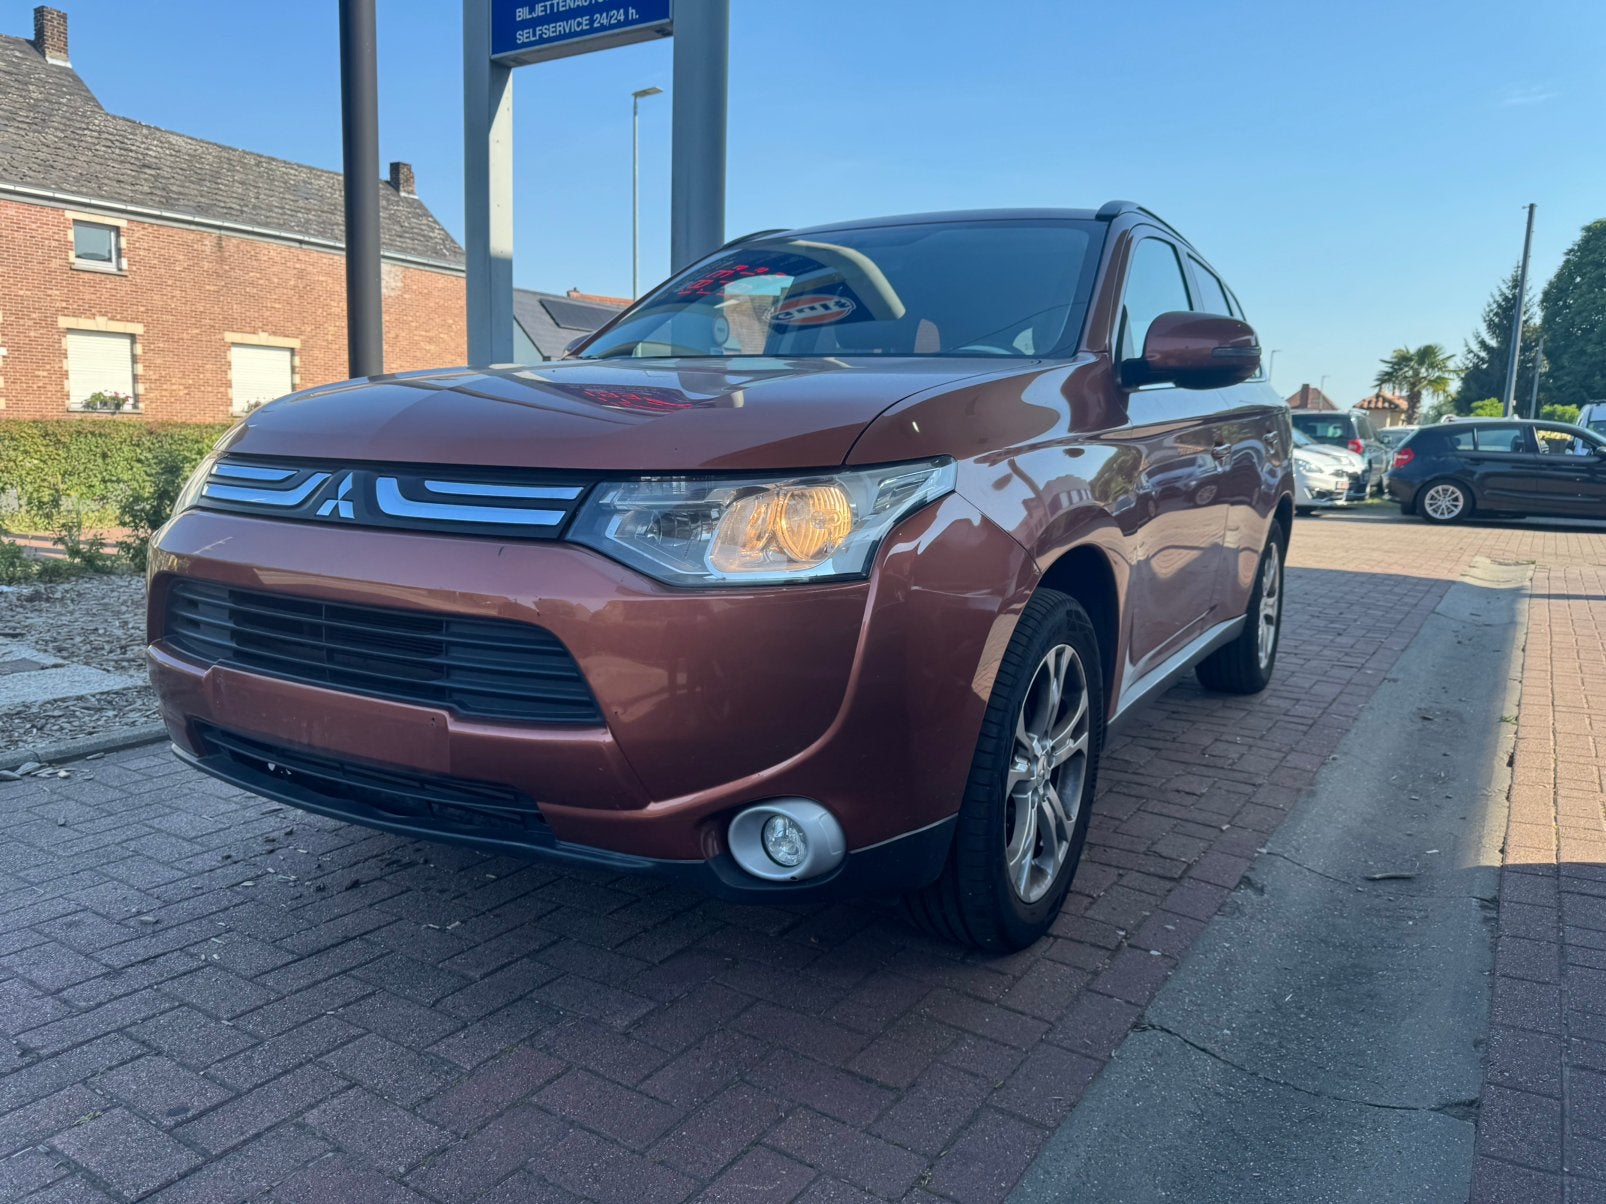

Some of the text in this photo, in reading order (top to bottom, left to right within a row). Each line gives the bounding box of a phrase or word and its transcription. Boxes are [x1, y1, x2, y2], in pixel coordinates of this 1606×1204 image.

[515, 0, 604, 21] BILJETTENAU
[516, 6, 640, 44] SELFSERVICE 24/24 h.
